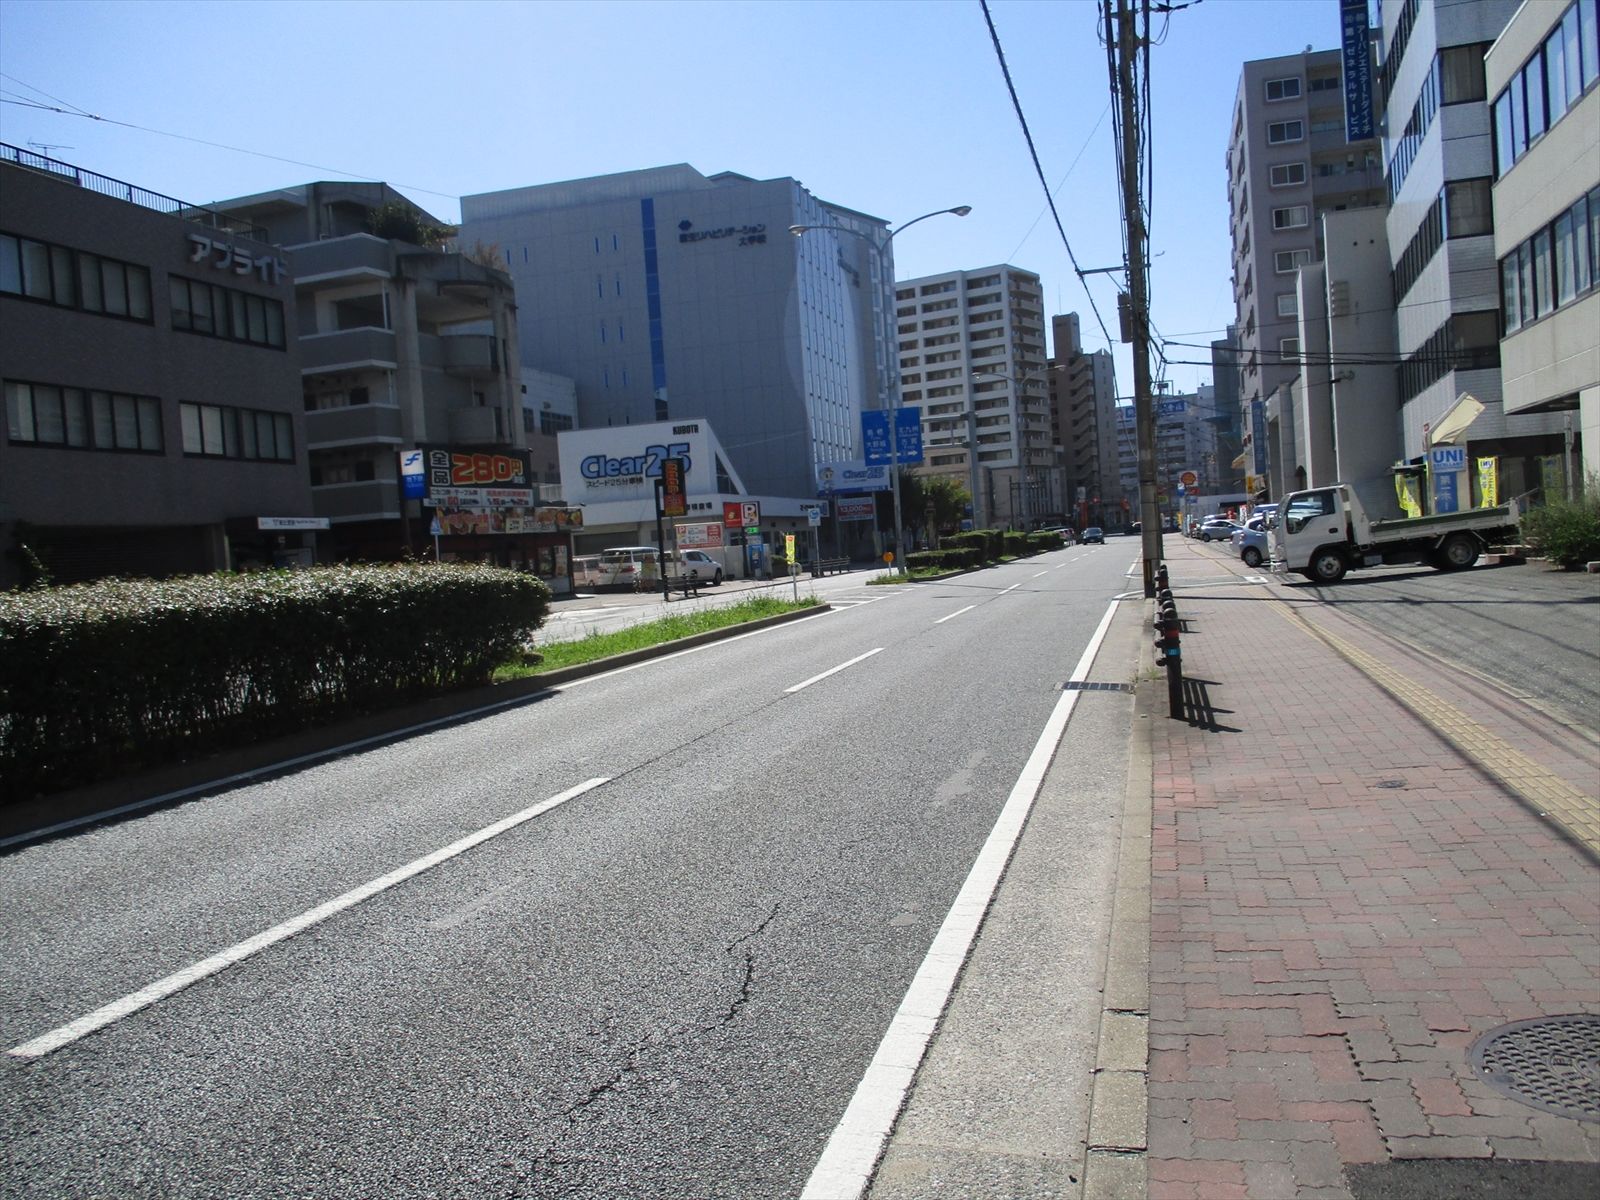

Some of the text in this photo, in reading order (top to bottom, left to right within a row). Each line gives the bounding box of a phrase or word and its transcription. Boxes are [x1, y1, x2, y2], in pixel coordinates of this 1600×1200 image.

[187, 233, 288, 285] アプライド
[672, 424, 699, 435] KUBOTA
[581, 442, 692, 479] Clear25
[1432, 449, 1464, 463] UNI
